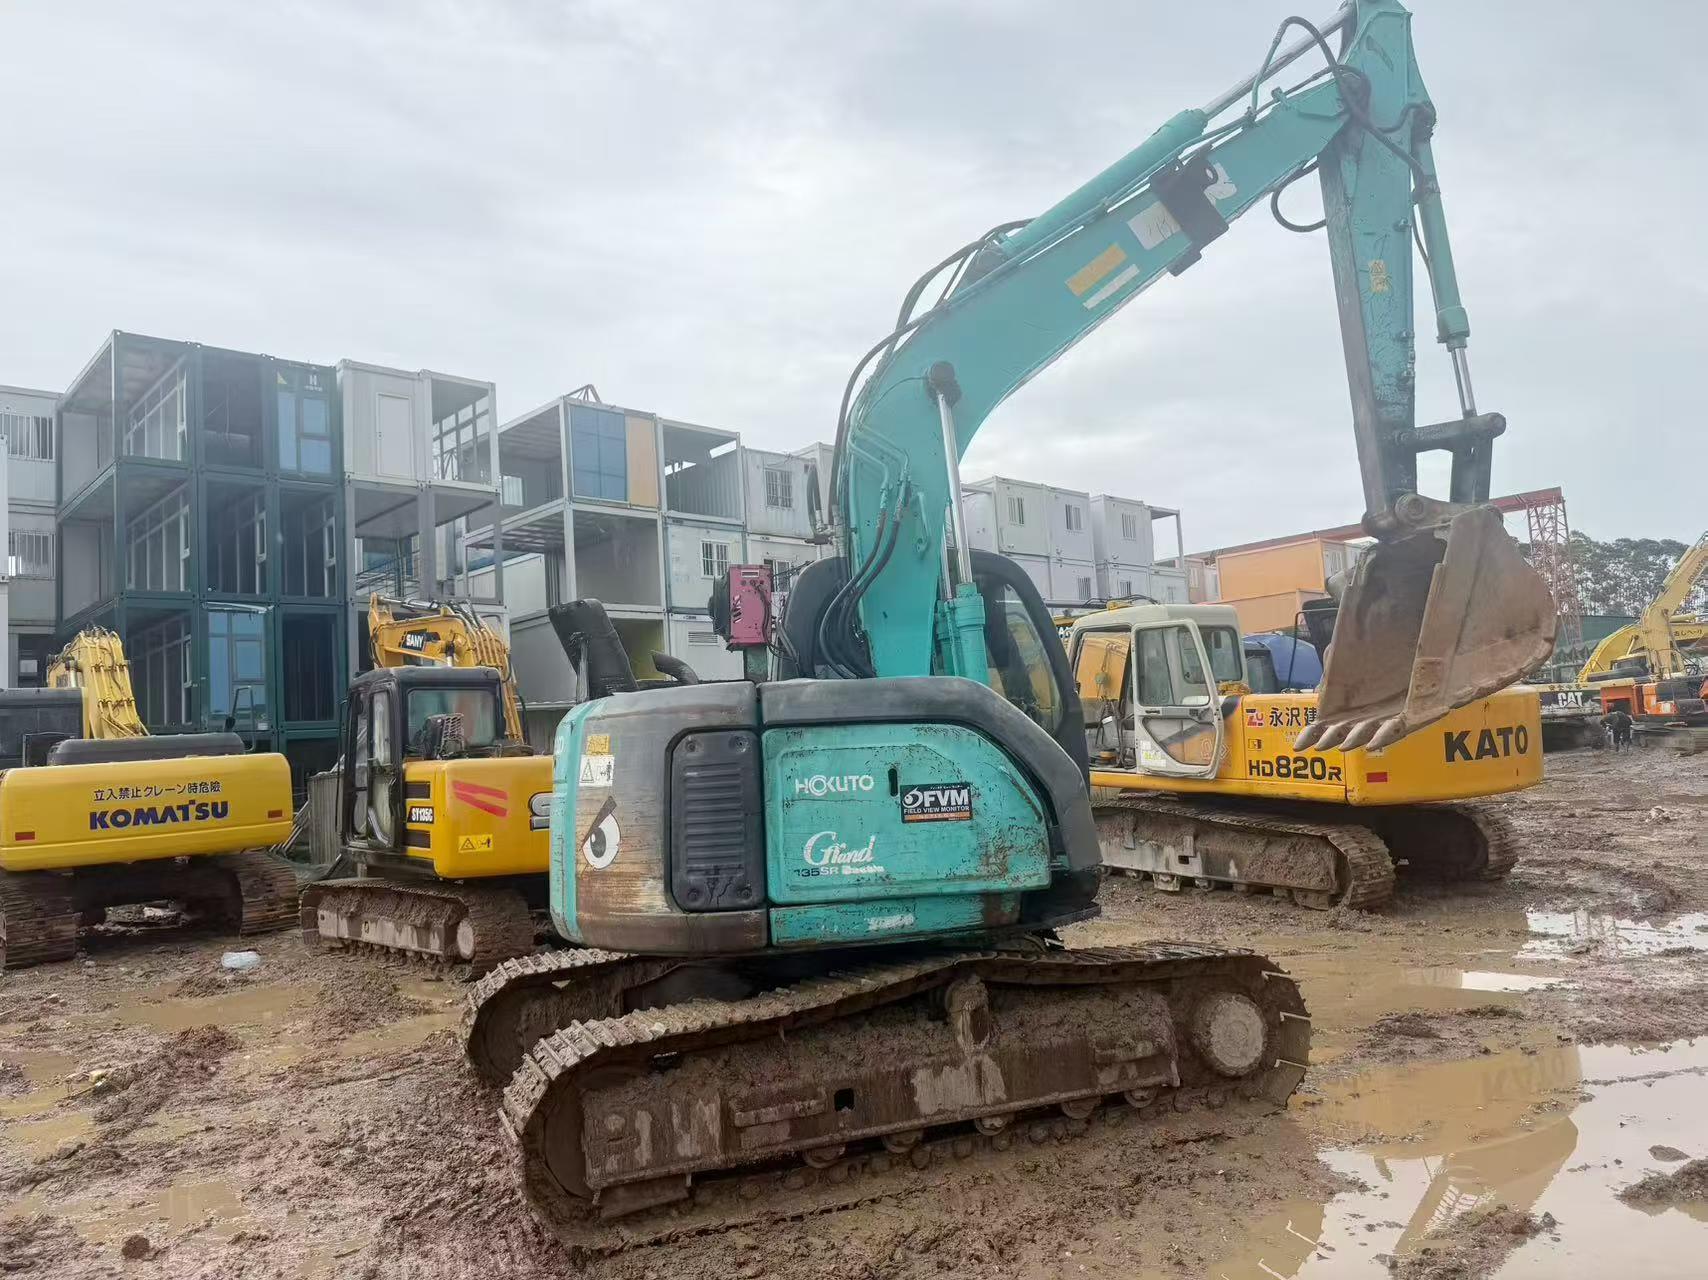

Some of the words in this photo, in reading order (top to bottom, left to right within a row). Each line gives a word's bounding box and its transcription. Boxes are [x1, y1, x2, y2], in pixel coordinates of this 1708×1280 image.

[406, 634, 424, 648] SANY
[1557, 691, 1584, 708] CAT
[1444, 725, 1528, 763] KATO
[1248, 755, 1342, 781] HD820R
[795, 774, 875, 796] HOKUTO
[923, 788, 969, 807] FVM
[89, 799, 229, 831] KOMATSU
[804, 831, 876, 866] Grand
